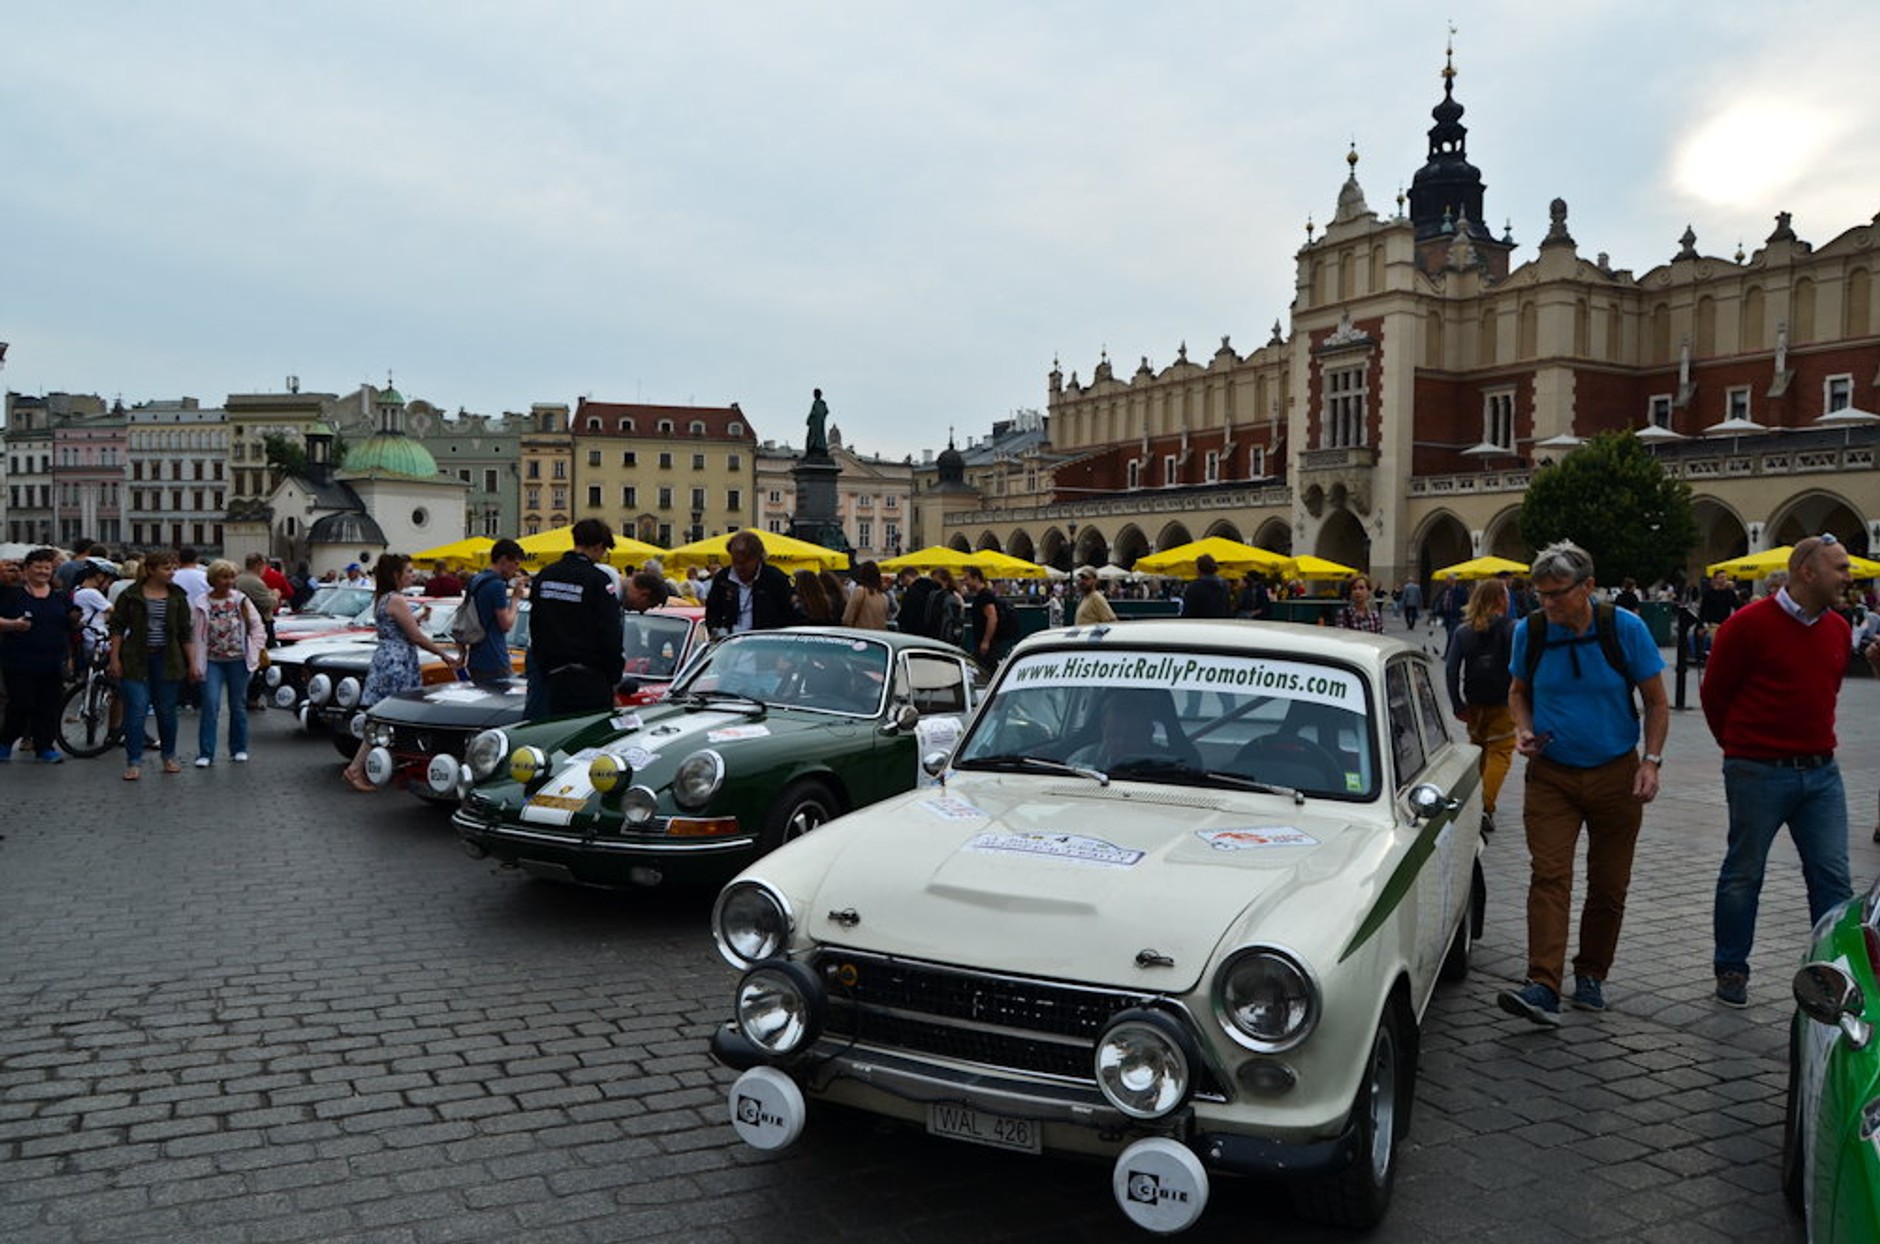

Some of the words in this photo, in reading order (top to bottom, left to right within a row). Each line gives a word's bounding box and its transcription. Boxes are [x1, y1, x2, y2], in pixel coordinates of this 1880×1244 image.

[1016, 656, 1347, 699] www.HistoricRallyPromotions.com
[939, 1106, 982, 1135] WAL
[994, 1118, 1028, 1143] 426
